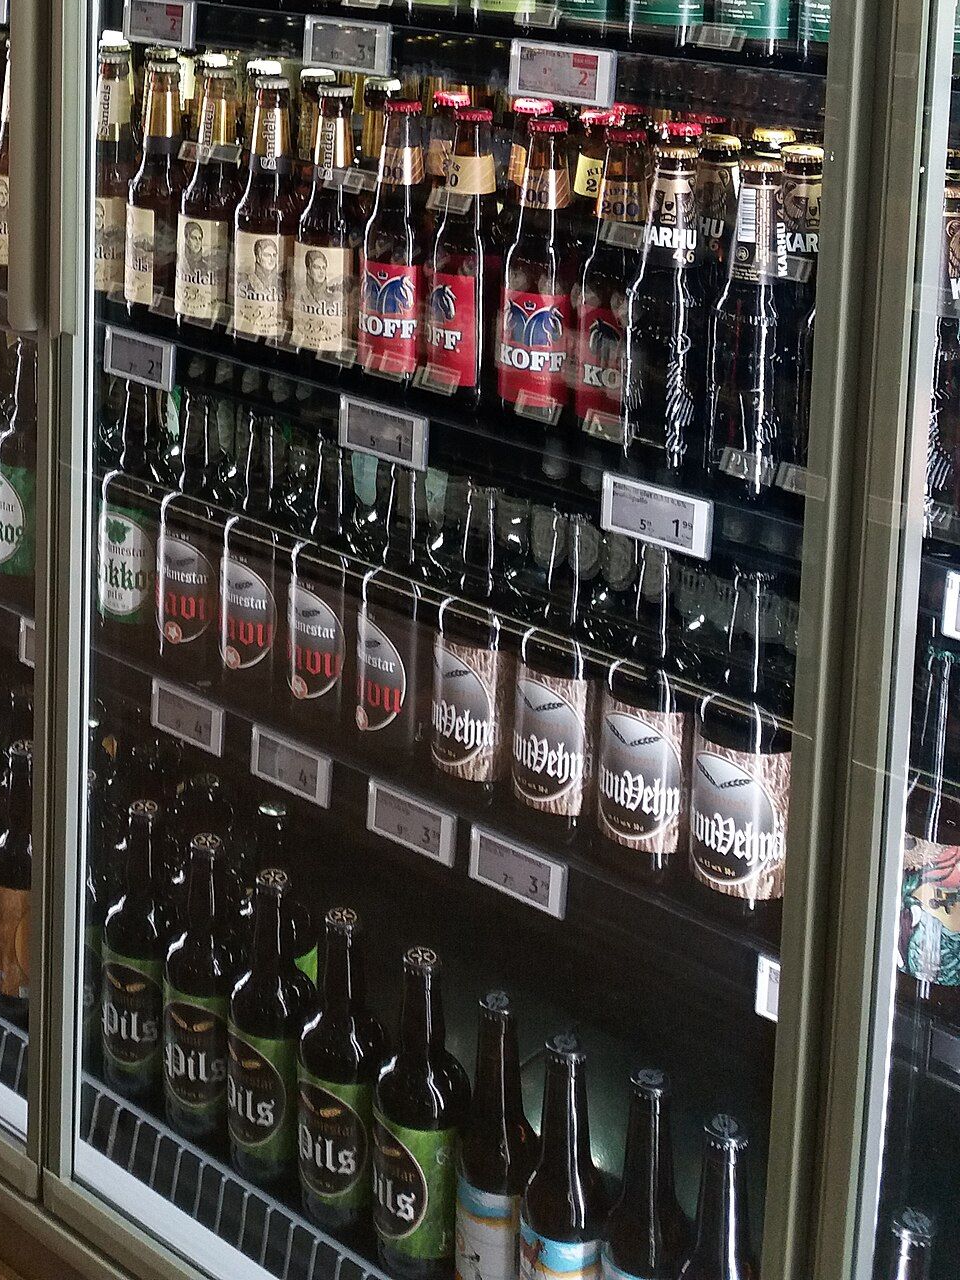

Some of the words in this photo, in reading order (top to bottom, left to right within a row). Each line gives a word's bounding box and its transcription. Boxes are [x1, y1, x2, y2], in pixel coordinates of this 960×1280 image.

[99, 83, 112, 137] Sandels
[261, 108, 278, 171] Sandels
[319, 121, 335, 181] Sandels
[601, 200, 640, 218] 200
[672, 249, 695, 265] 4,6
[776, 222, 788, 278] KARHU
[358, 312, 418, 340] KOFF
[498, 342, 567, 372] KOFF
[671, 518, 680, 538] 1
[101, 1000, 159, 1044] Pils
[165, 1041, 227, 1083] Pils
[298, 1122, 358, 1177] Pils
